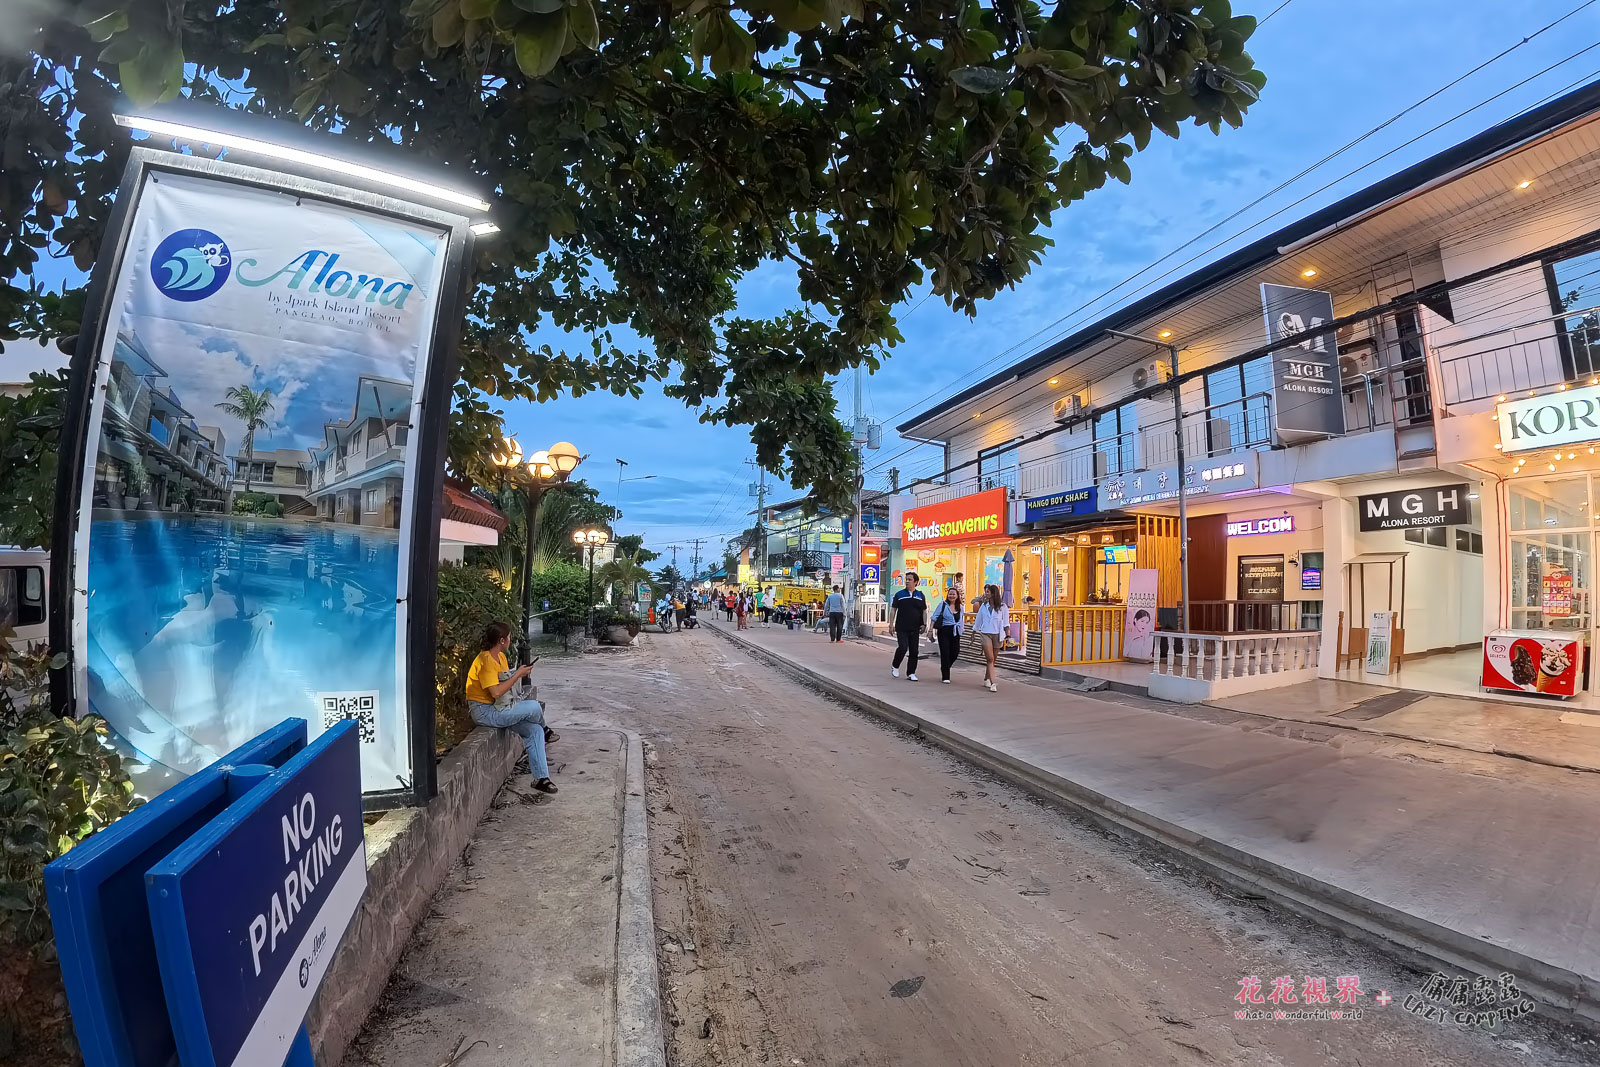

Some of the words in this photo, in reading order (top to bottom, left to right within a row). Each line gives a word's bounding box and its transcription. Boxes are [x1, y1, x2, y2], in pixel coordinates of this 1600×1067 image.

[236, 249, 413, 310] Alona
[268, 291, 280, 306] by
[286, 294, 318, 308] Jpark
[324, 300, 360, 315] Island
[364, 306, 402, 324] Resort
[348, 318, 391, 333] BOHOL
[1289, 362, 1325, 379] MGH
[1283, 383, 1306, 394] ALONA
[1308, 386, 1335, 395] RESORT
[1027, 498, 1050, 510] MANGO
[1050, 495, 1064, 506] BOY
[1064, 490, 1089, 503] SHAKE
[1226, 516, 1294, 537] WELCOM
[1380, 518, 1409, 528] ALONA
[1411, 515, 1446, 525] RESORT
[281, 792, 316, 865] NO
[248, 814, 343, 978] PARKING
